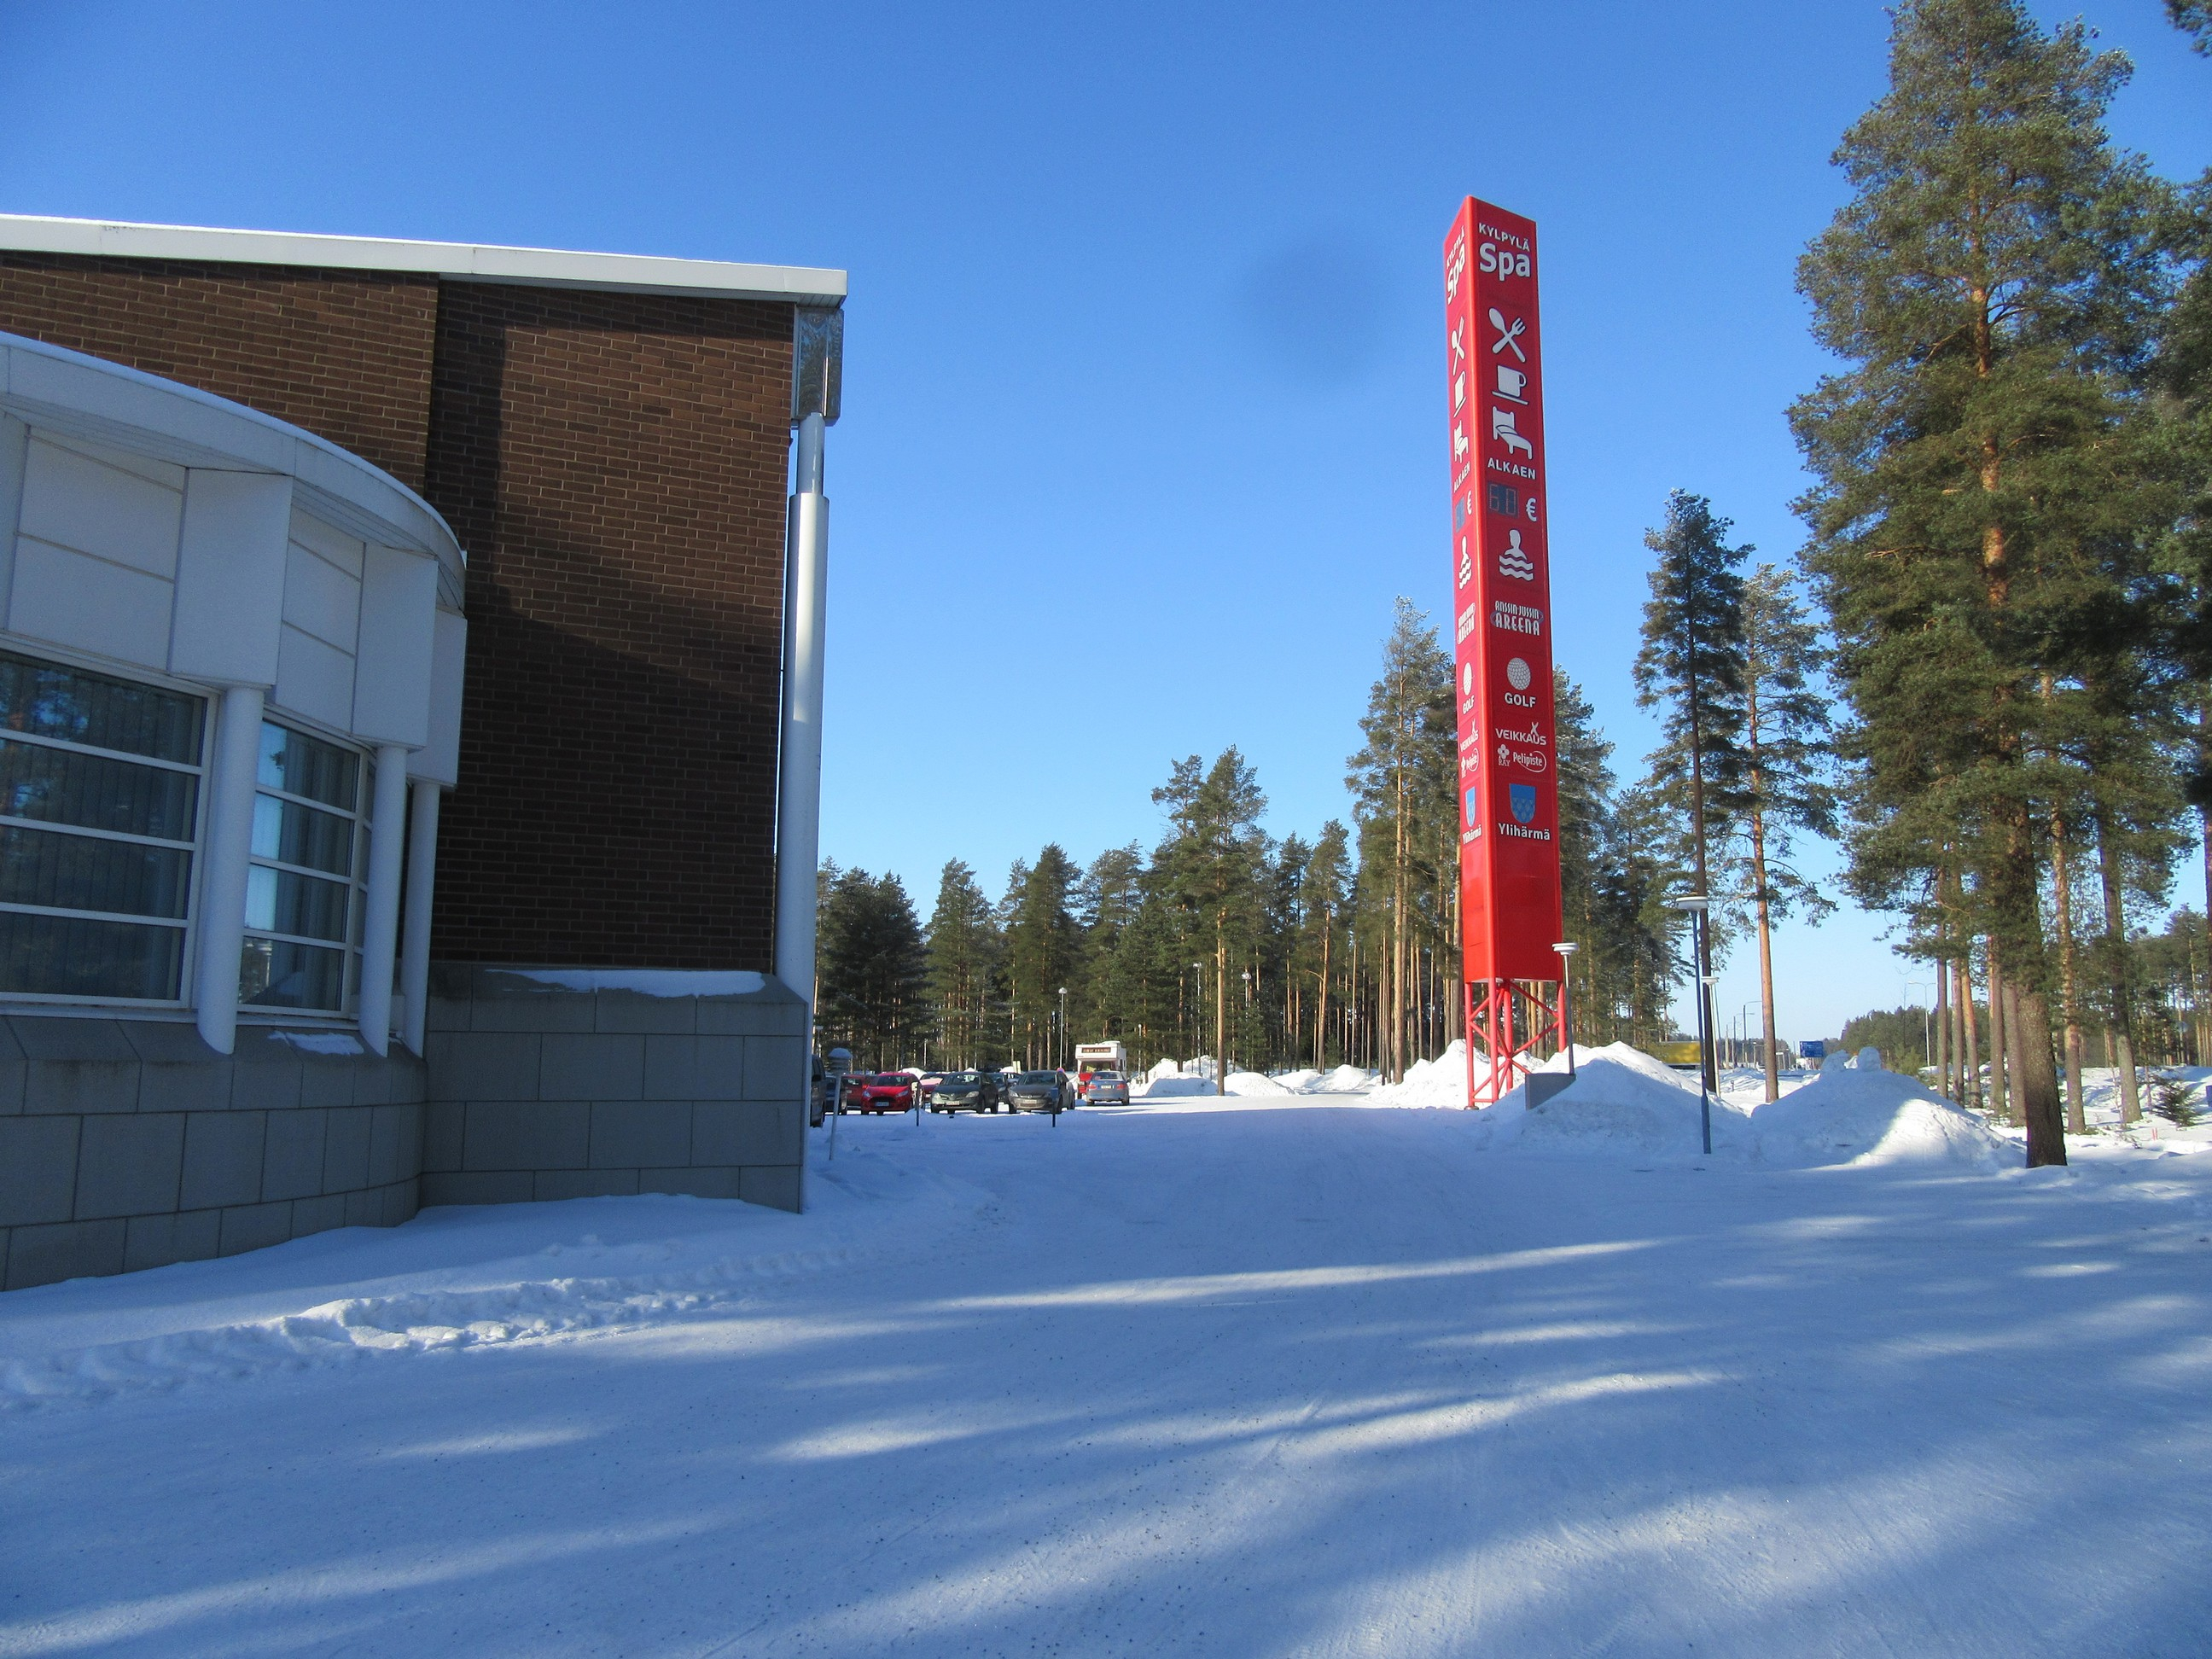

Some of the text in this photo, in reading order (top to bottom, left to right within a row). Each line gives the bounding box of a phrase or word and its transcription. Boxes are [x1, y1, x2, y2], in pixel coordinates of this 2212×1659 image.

[1479, 223, 1530, 252] KYLPYLÄ
[1479, 242, 1531, 282] Spa
[1447, 242, 1465, 306] Spa
[1487, 457, 1535, 480] ALKAEN
[1489, 484, 1537, 522] 60 €
[1495, 612, 1540, 637] AREENA
[1463, 696, 1475, 714] GOLF
[1505, 692, 1536, 708] GOLF
[1495, 727, 1546, 746] VEIKKAUS
[1513, 751, 1543, 767] Pelipiste
[1498, 822, 1551, 841] Ylihärmä
